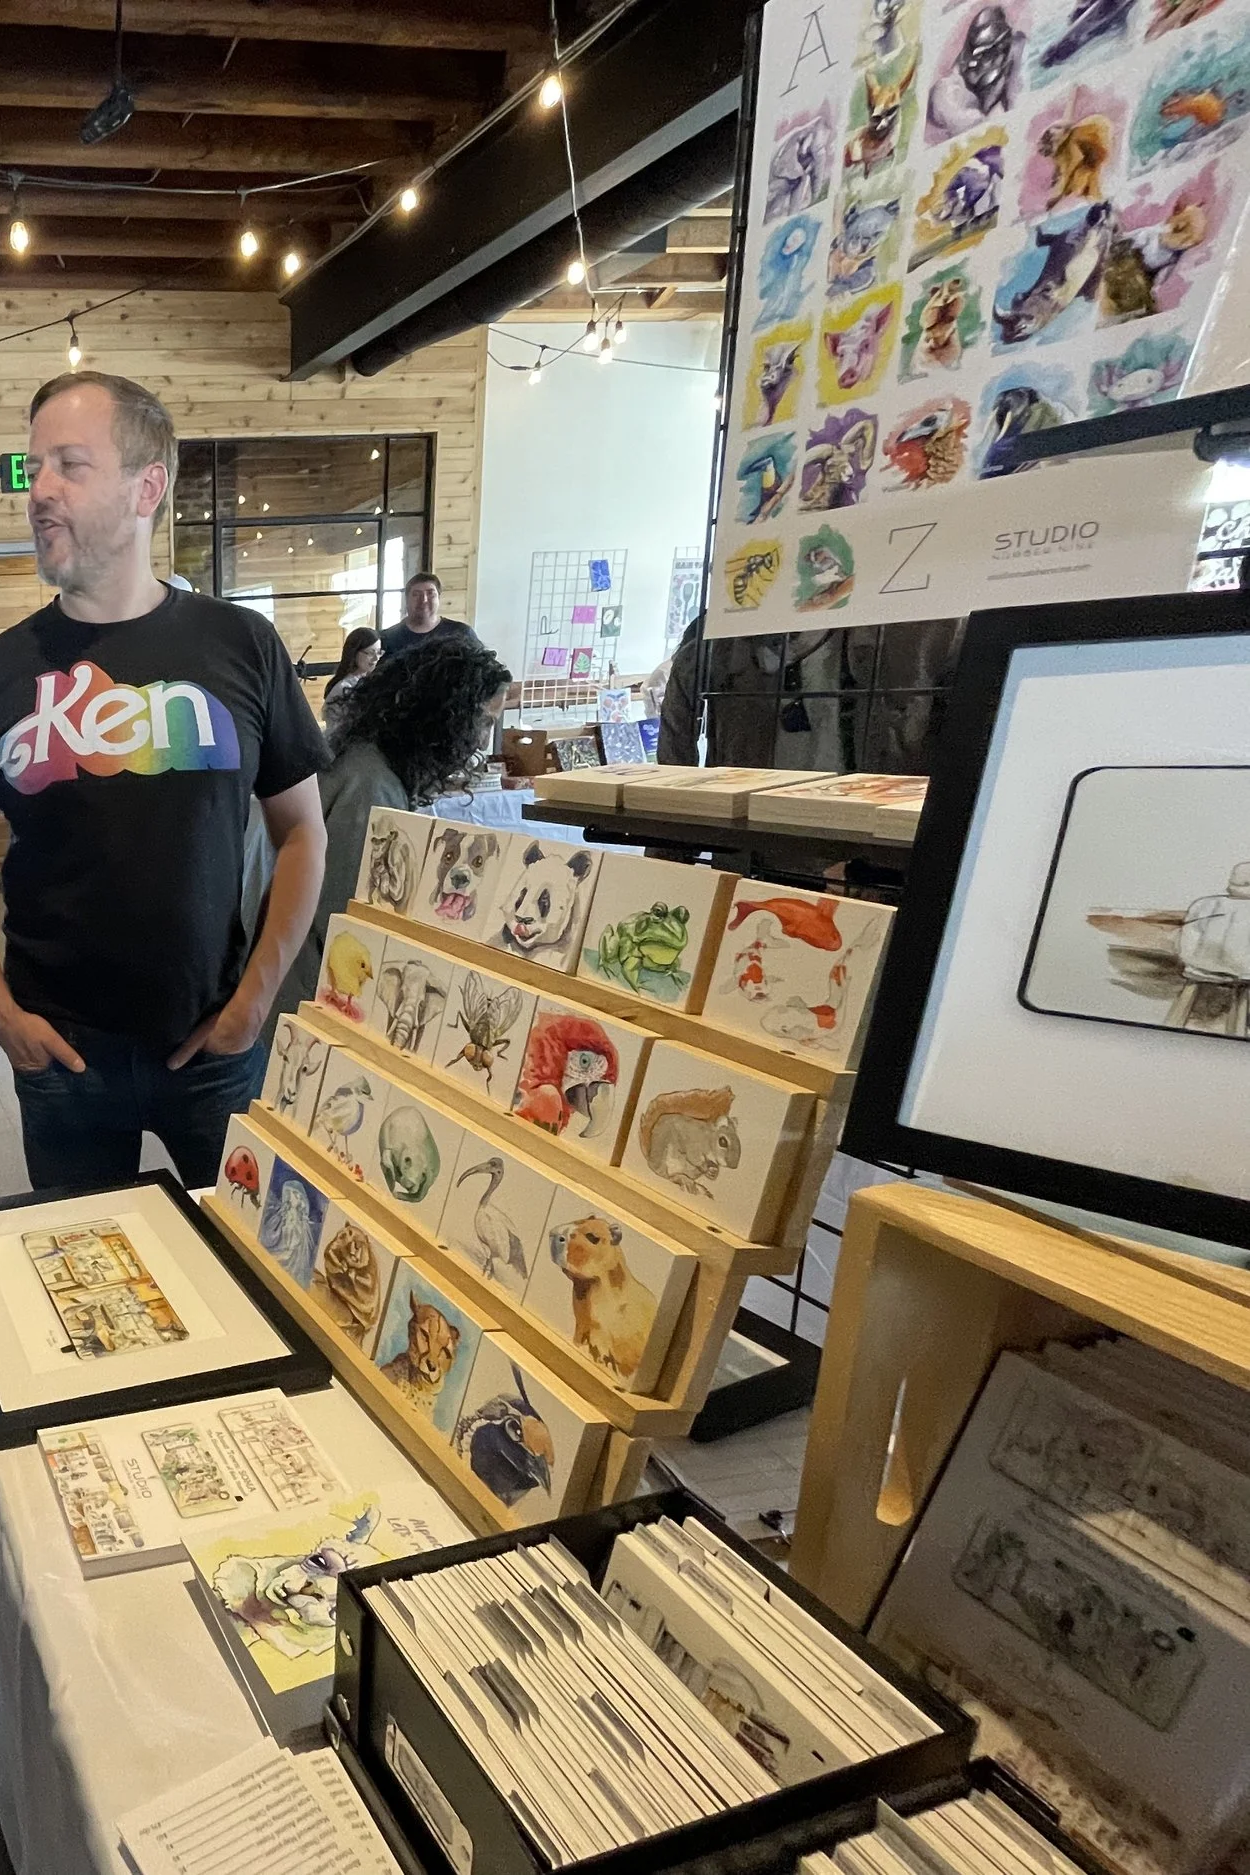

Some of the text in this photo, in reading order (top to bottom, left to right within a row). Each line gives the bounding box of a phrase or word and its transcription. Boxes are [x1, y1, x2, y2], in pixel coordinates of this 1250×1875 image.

[779, 4, 839, 98] A
[878, 522, 938, 594] Z
[994, 521, 1099, 551] STUDIO
[0, 664, 216, 778] Ken
[127, 1458, 152, 1498] STUDIO
